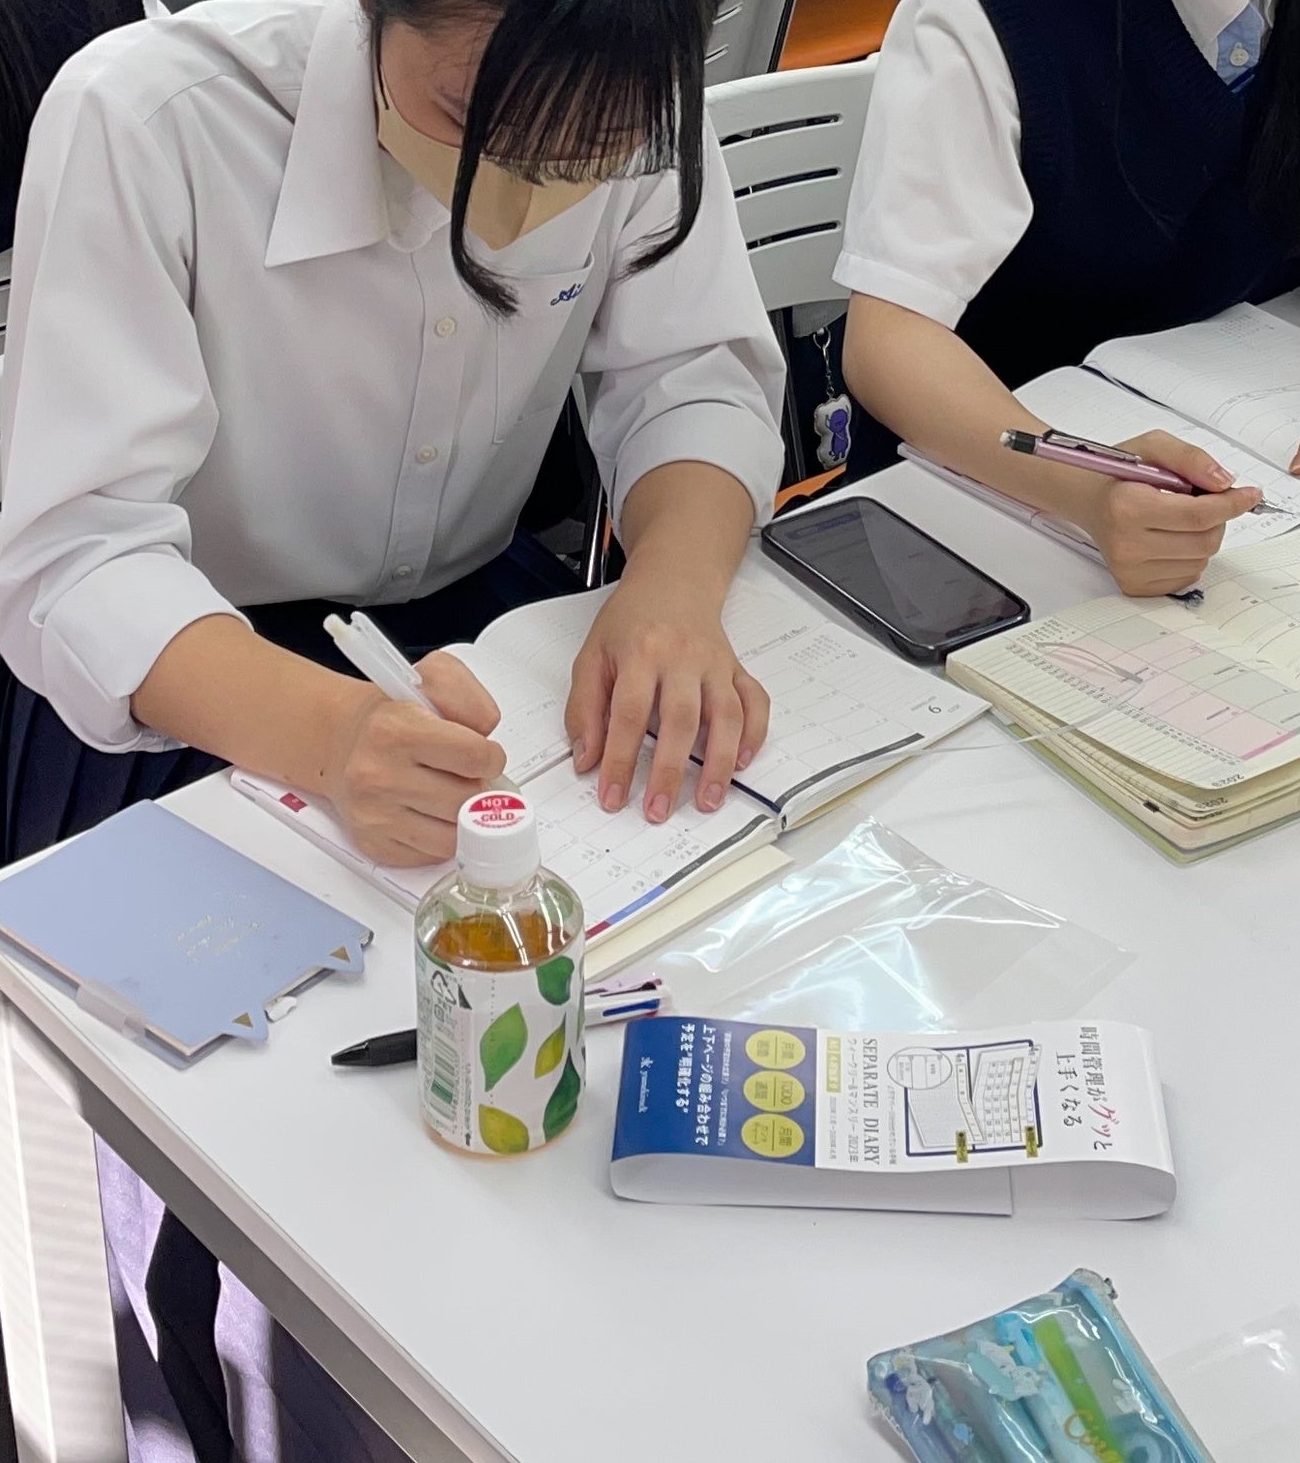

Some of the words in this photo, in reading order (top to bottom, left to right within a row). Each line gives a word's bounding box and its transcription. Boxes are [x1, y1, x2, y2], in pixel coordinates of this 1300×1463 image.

[481, 798, 511, 807] HOT
[481, 812, 514, 822] COLD
[695, 1024, 716, 1146] 上下ページの組み合わせで
[863, 1038, 879, 1108] SEPARATE
[1055, 1052, 1082, 1127] 上手くなる
[1079, 1026, 1119, 1151] 時間管理がグッと
[863, 1118, 880, 1165] DIARY
